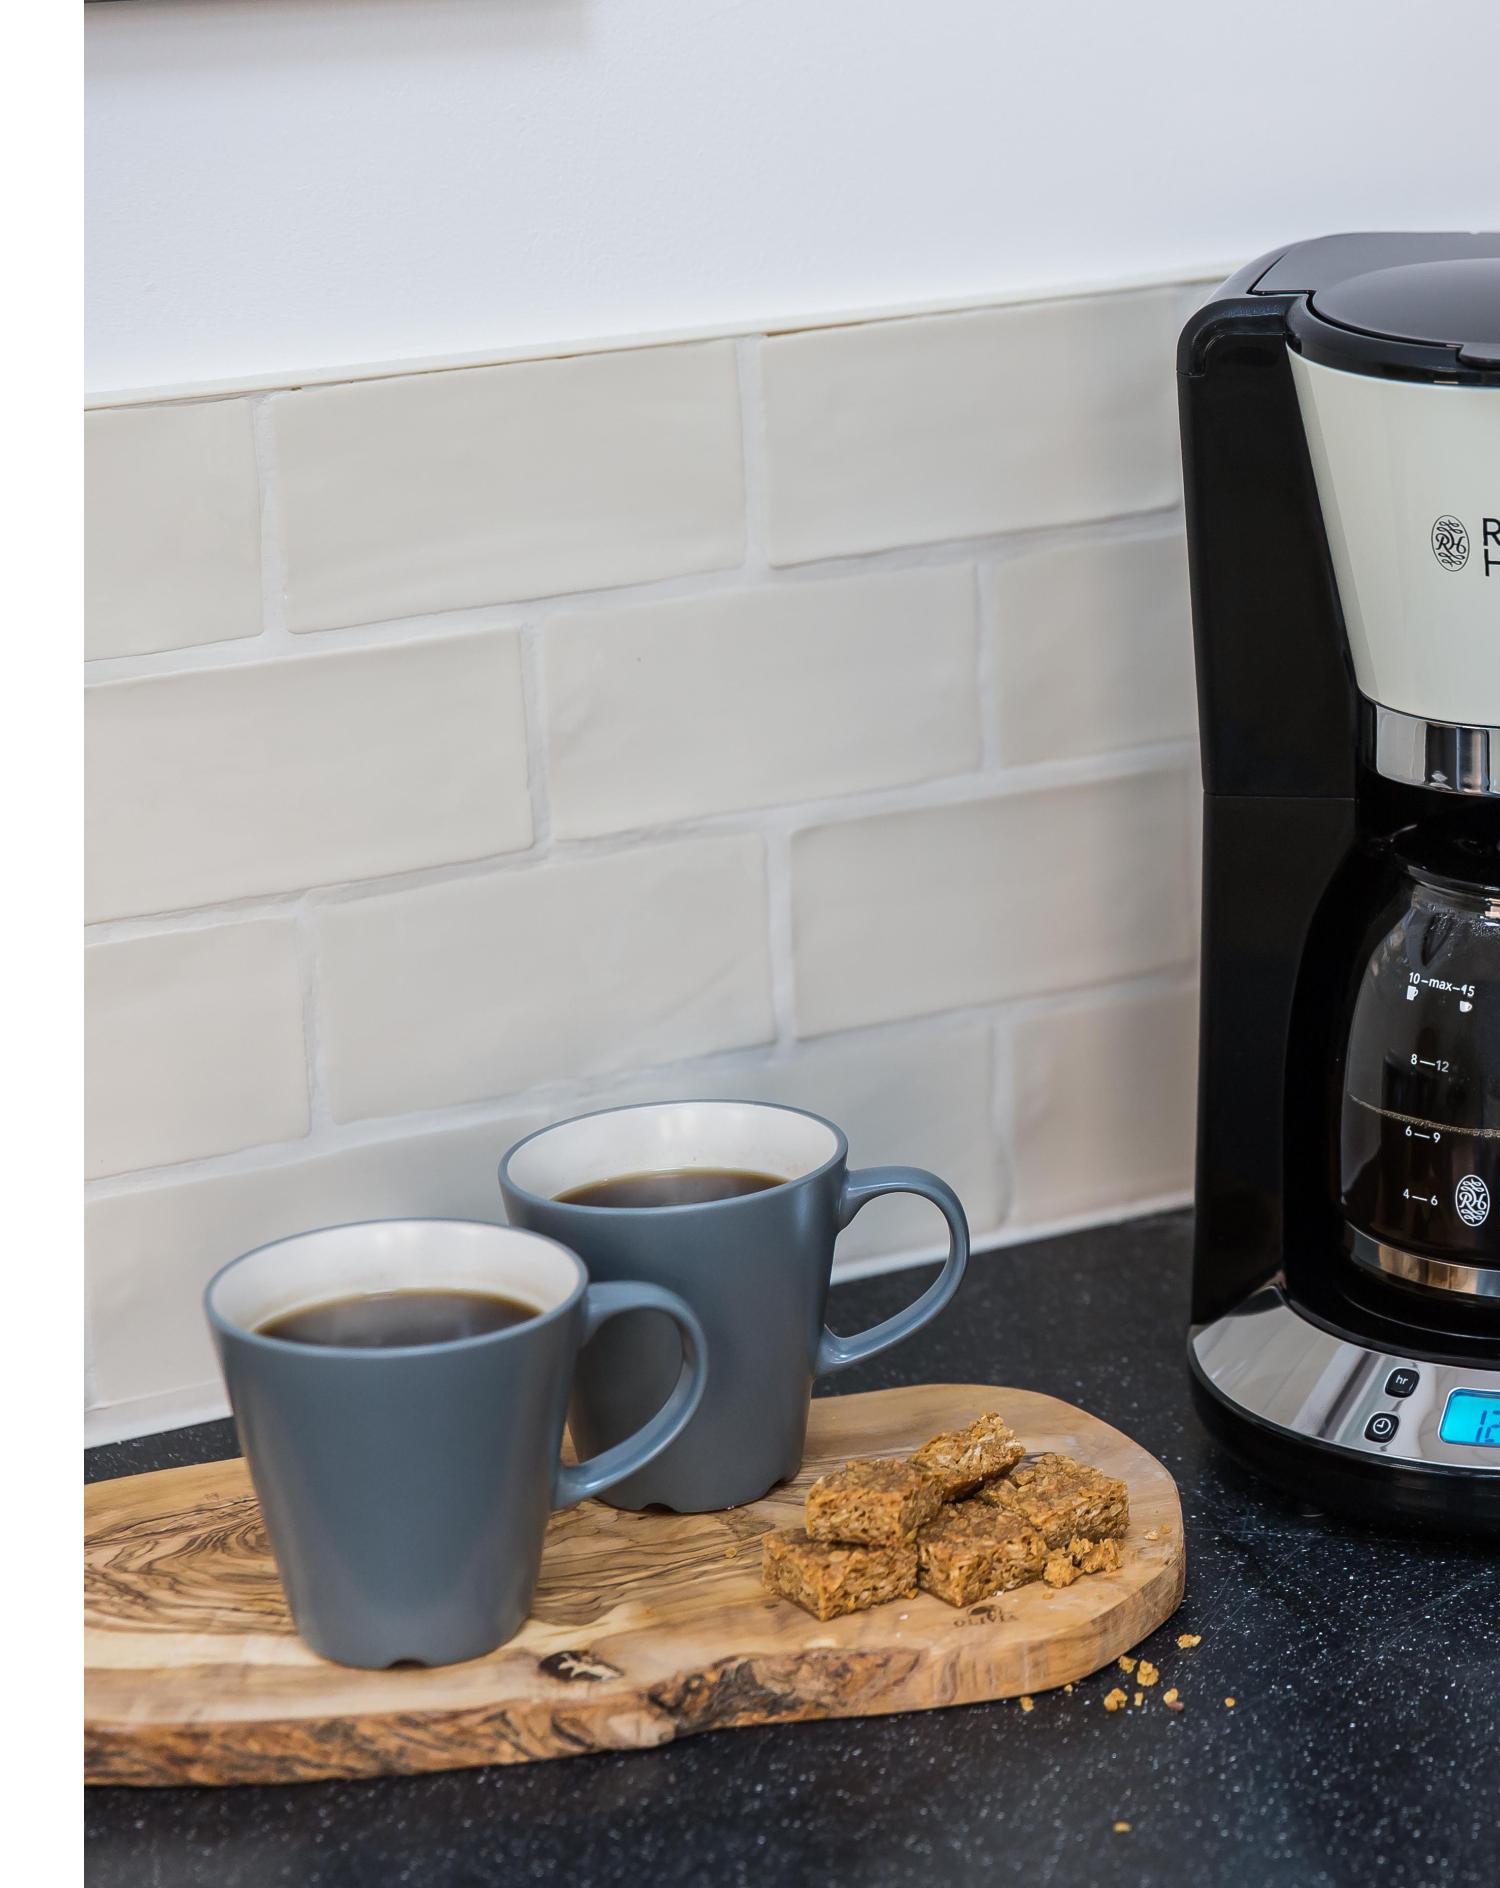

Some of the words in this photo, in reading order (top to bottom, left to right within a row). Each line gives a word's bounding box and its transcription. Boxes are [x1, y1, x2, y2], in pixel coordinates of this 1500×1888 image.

[1411, 1053, 1418, 1065] 8
[1436, 1060, 1449, 1073] 12
[1405, 1126, 1412, 1137] 6
[1433, 1132, 1441, 1144] 9
[1403, 1188, 1410, 1199] 4
[1431, 1195, 1438, 1206] 6
[1395, 1375, 1408, 1385] hr
